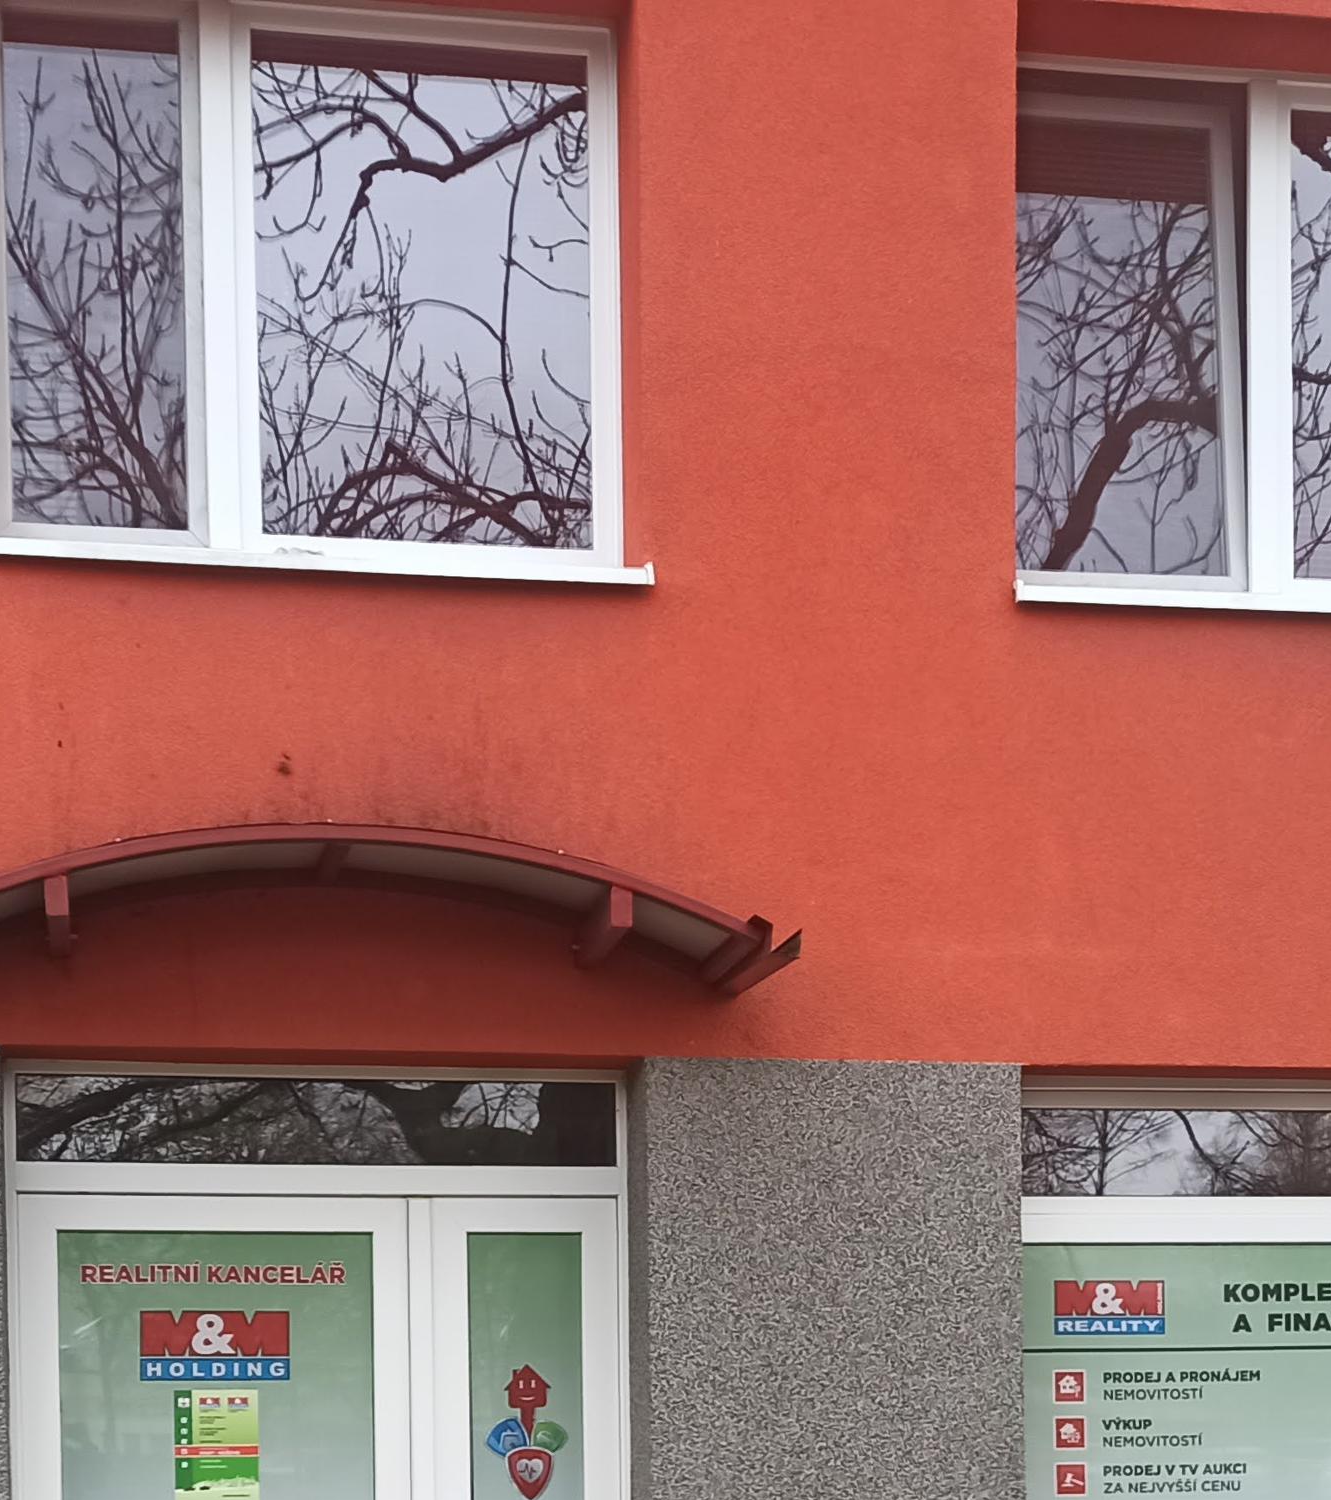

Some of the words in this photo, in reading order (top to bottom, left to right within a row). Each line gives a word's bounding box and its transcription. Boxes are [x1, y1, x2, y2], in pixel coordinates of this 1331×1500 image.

[80, 1262, 200, 1284] REALITNÍ
[207, 1262, 346, 1284] KANCELÁŘ
[1054, 1280, 1165, 1316] M&M
[1058, 1320, 1160, 1332] REALITY
[1232, 1313, 1252, 1333] A
[140, 1310, 290, 1356] M&M
[146, 1362, 285, 1377] HOLDING
[1102, 1370, 1162, 1384] PRODEJ
[1164, 1371, 1177, 1383] A
[1179, 1368, 1261, 1383] PRONÁJEM
[1103, 1385, 1203, 1402] NEMOVITOSTÍ
[1102, 1418, 1153, 1432] VÝKUP
[1102, 1432, 1203, 1449] NEMOVITOSTÍ
[1103, 1463, 1163, 1478] PRODEJ
[1165, 1464, 1177, 1477] V
[1179, 1463, 1200, 1477] TV
[1202, 1462, 1248, 1475] AUKCI
[1103, 1481, 1125, 1494] ZA
[1128, 1478, 1199, 1494] NEJVYŠŠÍ
[1201, 1479, 1241, 1493] CENU
